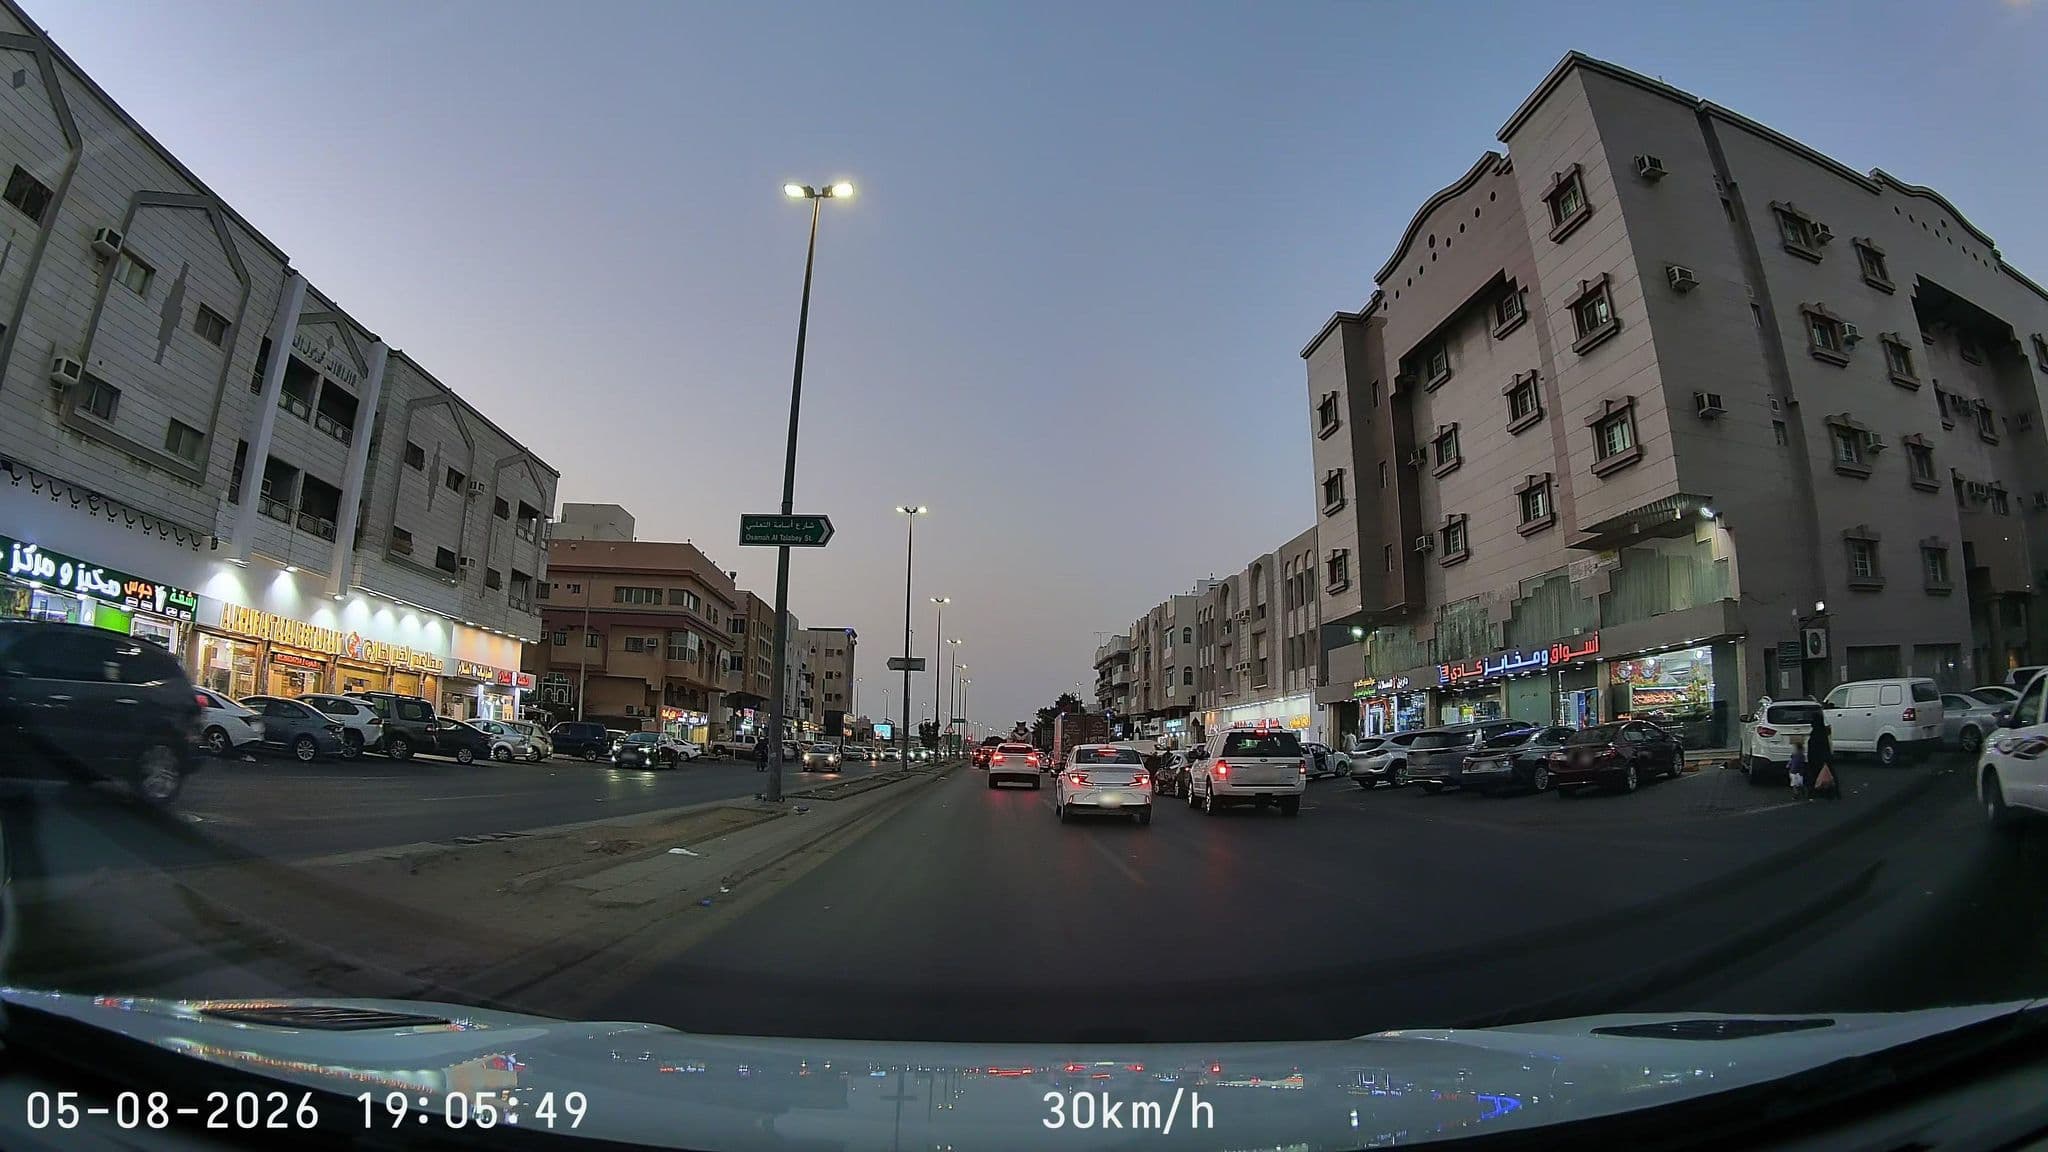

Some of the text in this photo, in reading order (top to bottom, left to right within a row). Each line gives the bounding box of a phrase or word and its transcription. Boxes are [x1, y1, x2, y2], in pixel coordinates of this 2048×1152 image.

[773, 519, 794, 529] أسامة
[795, 520, 815, 531] شارع
[771, 533, 778, 541] Al
[10, 543, 55, 578] مركز
[59, 562, 73, 586] و
[123, 581, 153, 599] جوس
[169, 587, 197, 612] رشفة
[410, 649, 446, 675] مطاعم
[1449, 630, 1600, 684] أسواق ومخابز كادي
